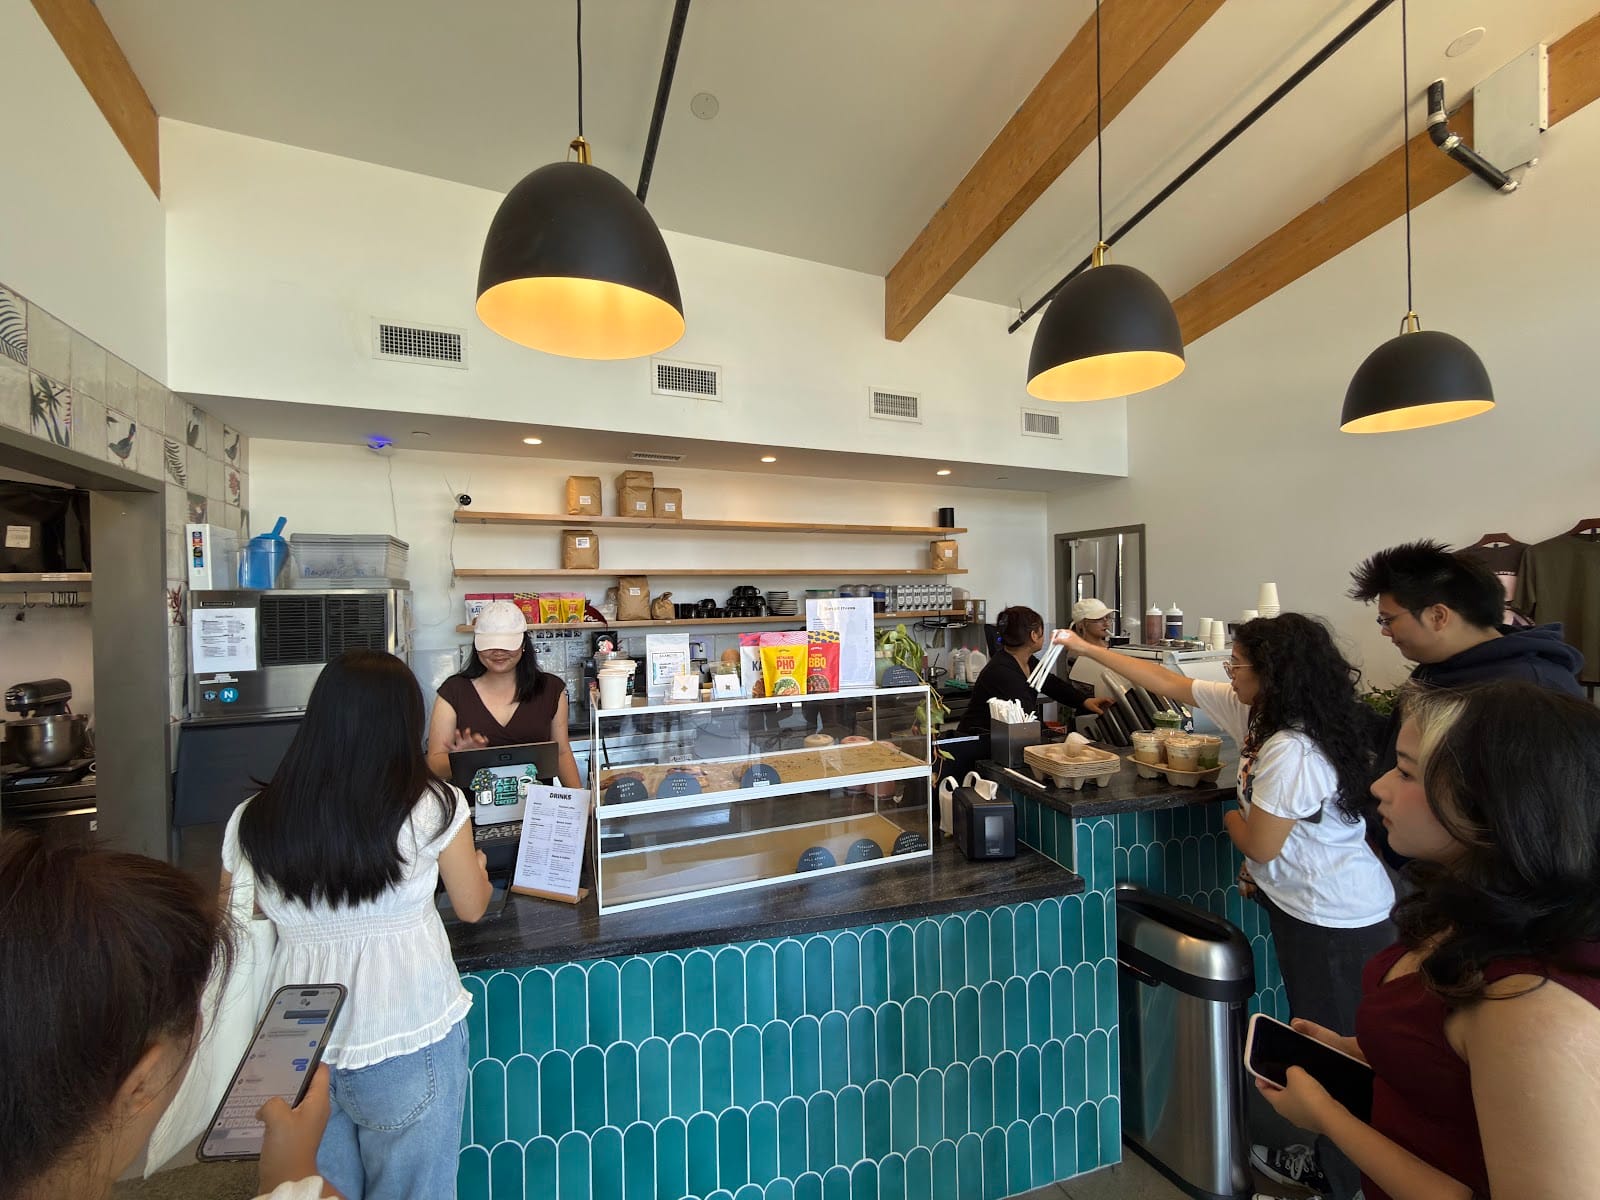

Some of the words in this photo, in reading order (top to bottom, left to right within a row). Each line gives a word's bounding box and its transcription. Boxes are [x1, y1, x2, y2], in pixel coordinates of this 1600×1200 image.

[776, 659, 795, 671] PHO
[808, 657, 827, 669] BBQ
[549, 792, 572, 801] DRINKS
[475, 825, 522, 836] CASH
